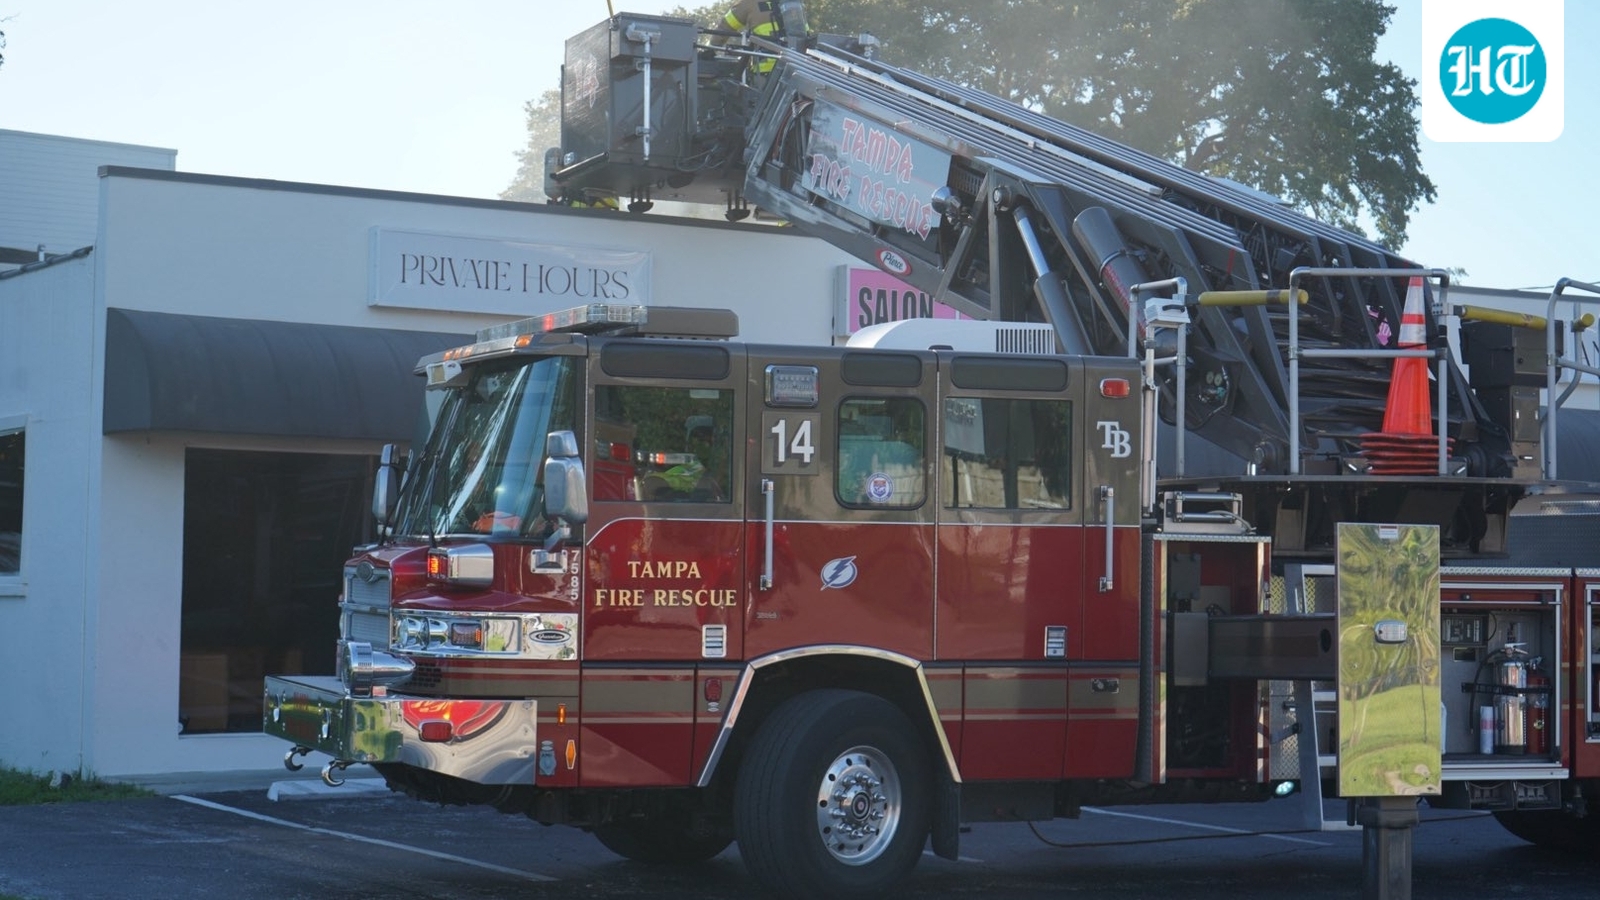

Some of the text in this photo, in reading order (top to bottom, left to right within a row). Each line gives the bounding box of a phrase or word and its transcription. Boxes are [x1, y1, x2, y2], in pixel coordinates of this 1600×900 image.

[841, 117, 914, 184] TAMPA
[810, 153, 934, 241] FIRE RESCUE
[400, 253, 630, 300] PRIVATE HOURS
[858, 286, 934, 328] SALON
[771, 419, 815, 463] 14
[1096, 421, 1131, 458] TB
[570, 549, 580, 601] 7585
[627, 561, 702, 579] TAMPA
[595, 589, 737, 607] FIRE RESCUE
